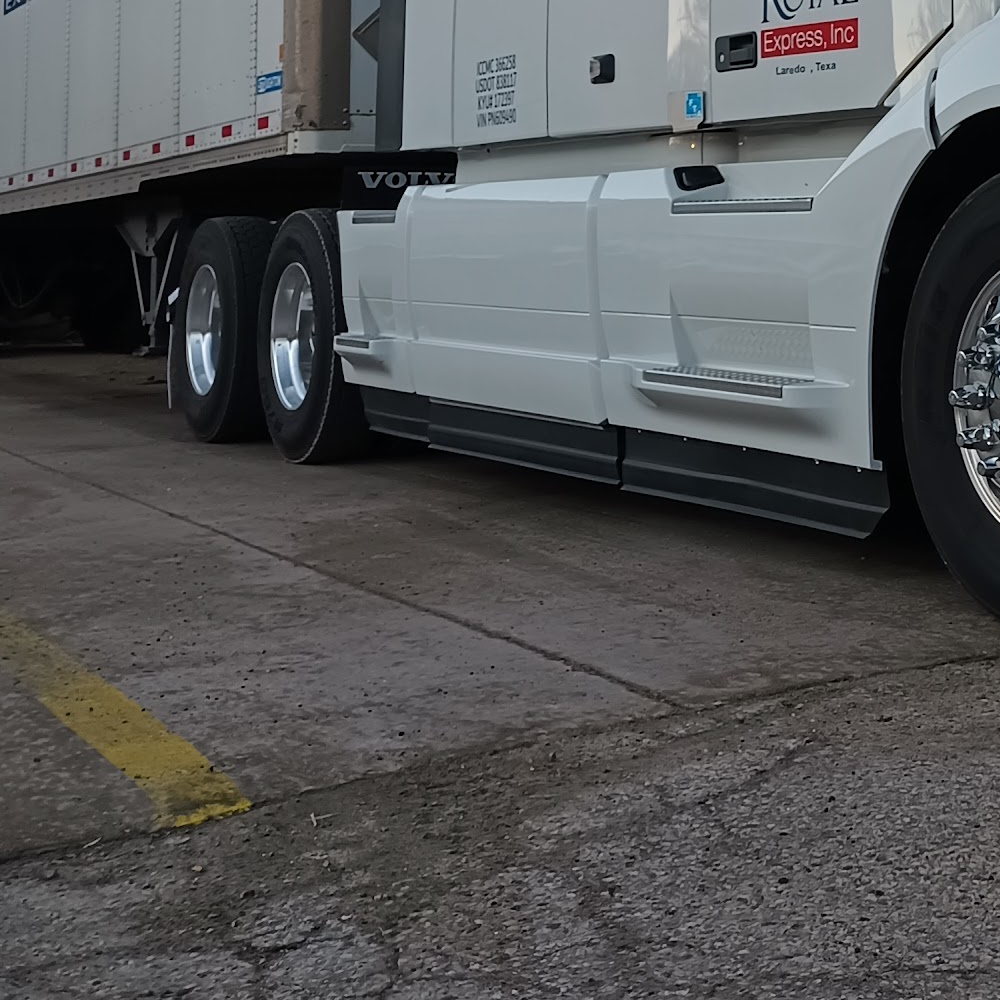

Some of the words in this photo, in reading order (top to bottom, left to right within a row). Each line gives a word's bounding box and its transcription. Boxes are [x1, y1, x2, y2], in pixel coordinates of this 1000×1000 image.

[763, 29, 827, 55] Express,
[830, 23, 855, 45] Inc
[775, 64, 806, 75] Laredo
[815, 62, 837, 72] Texa
[357, 171, 457, 189] VOLV
